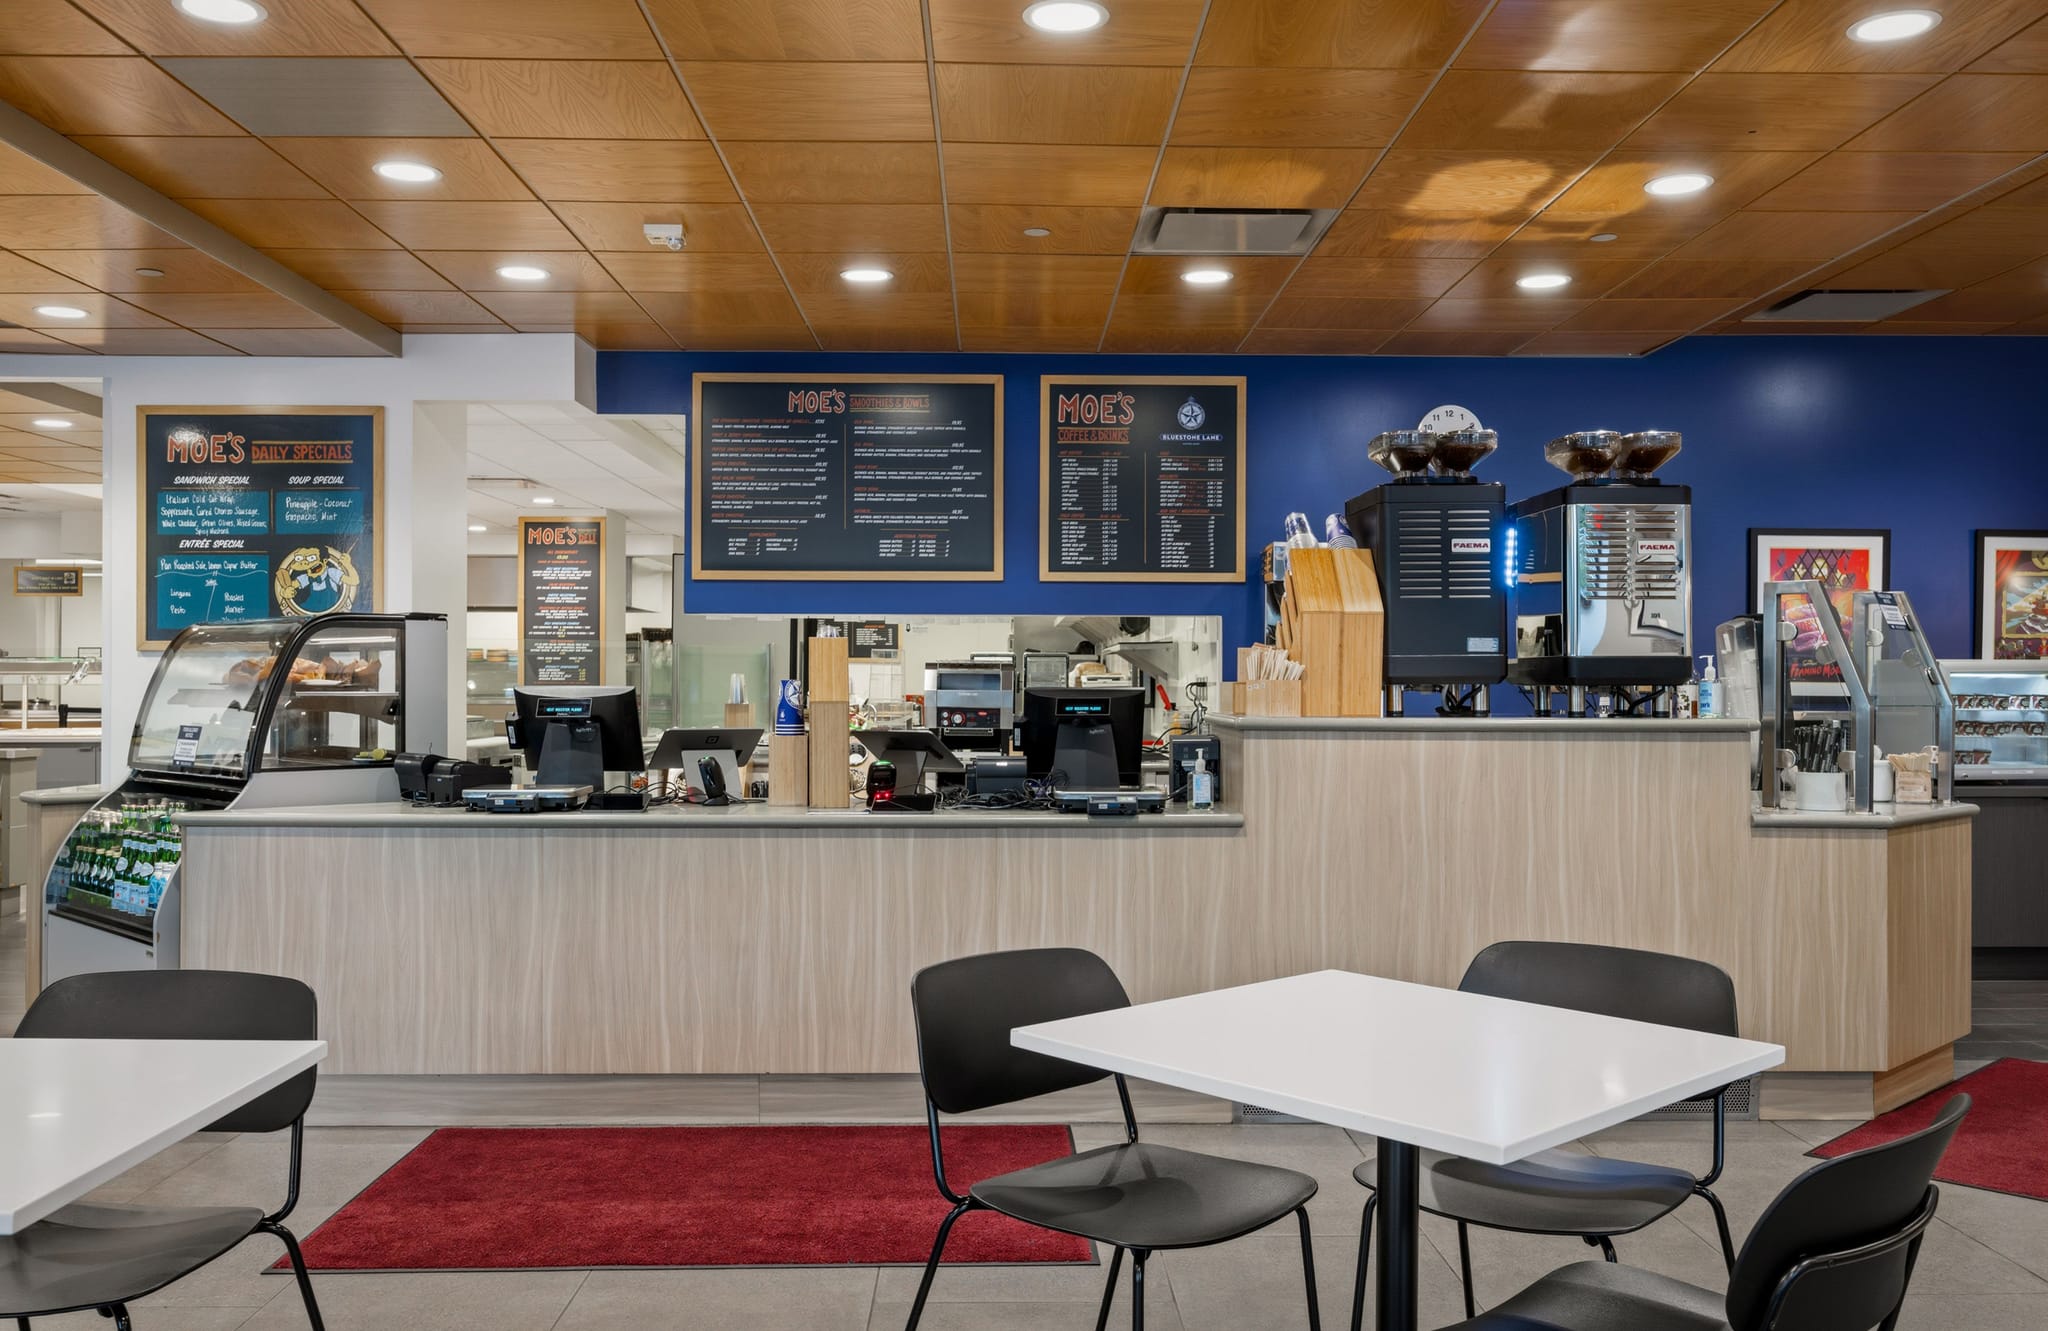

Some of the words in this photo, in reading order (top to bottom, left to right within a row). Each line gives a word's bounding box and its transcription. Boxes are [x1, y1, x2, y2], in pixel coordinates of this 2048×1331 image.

[787, 388, 845, 414] MOE'S
[849, 398, 893, 408] SMOOTHIES
[894, 398, 902, 408] &
[902, 398, 930, 408] BOWLS
[1057, 391, 1136, 425] MOE'S
[1445, 409, 1454, 417] 12
[1058, 430, 1089, 441] COFFEE
[1090, 430, 1098, 441] &
[1098, 430, 1129, 441] DRINKS
[167, 431, 246, 464] MOE'S
[251, 445, 289, 460] DAILY
[292, 444, 352, 460] SPECIALS
[173, 475, 216, 485] SANDWICH
[217, 475, 251, 485] SPECIAL
[288, 475, 311, 485] SOUP
[312, 475, 344, 485] SPECIAL
[166, 494, 189, 504] Italian
[192, 494, 206, 504] Cold
[286, 496, 318, 511] Pineapple
[324, 498, 353, 508] Coconut
[196, 506, 213, 516] Cured
[321, 511, 338, 521] Mint
[201, 518, 216, 527] Green
[527, 526, 577, 545] MOE'S
[179, 537, 211, 549] ENTRÉE
[212, 539, 245, 549] SPECIAL
[160, 558, 172, 571] Pan
[173, 559, 195, 570] Roasted
[240, 560, 259, 570] Butter
[224, 591, 244, 602] Roasted
[170, 604, 186, 614] Pesto
[1791, 662, 1822, 677] FLAMING
